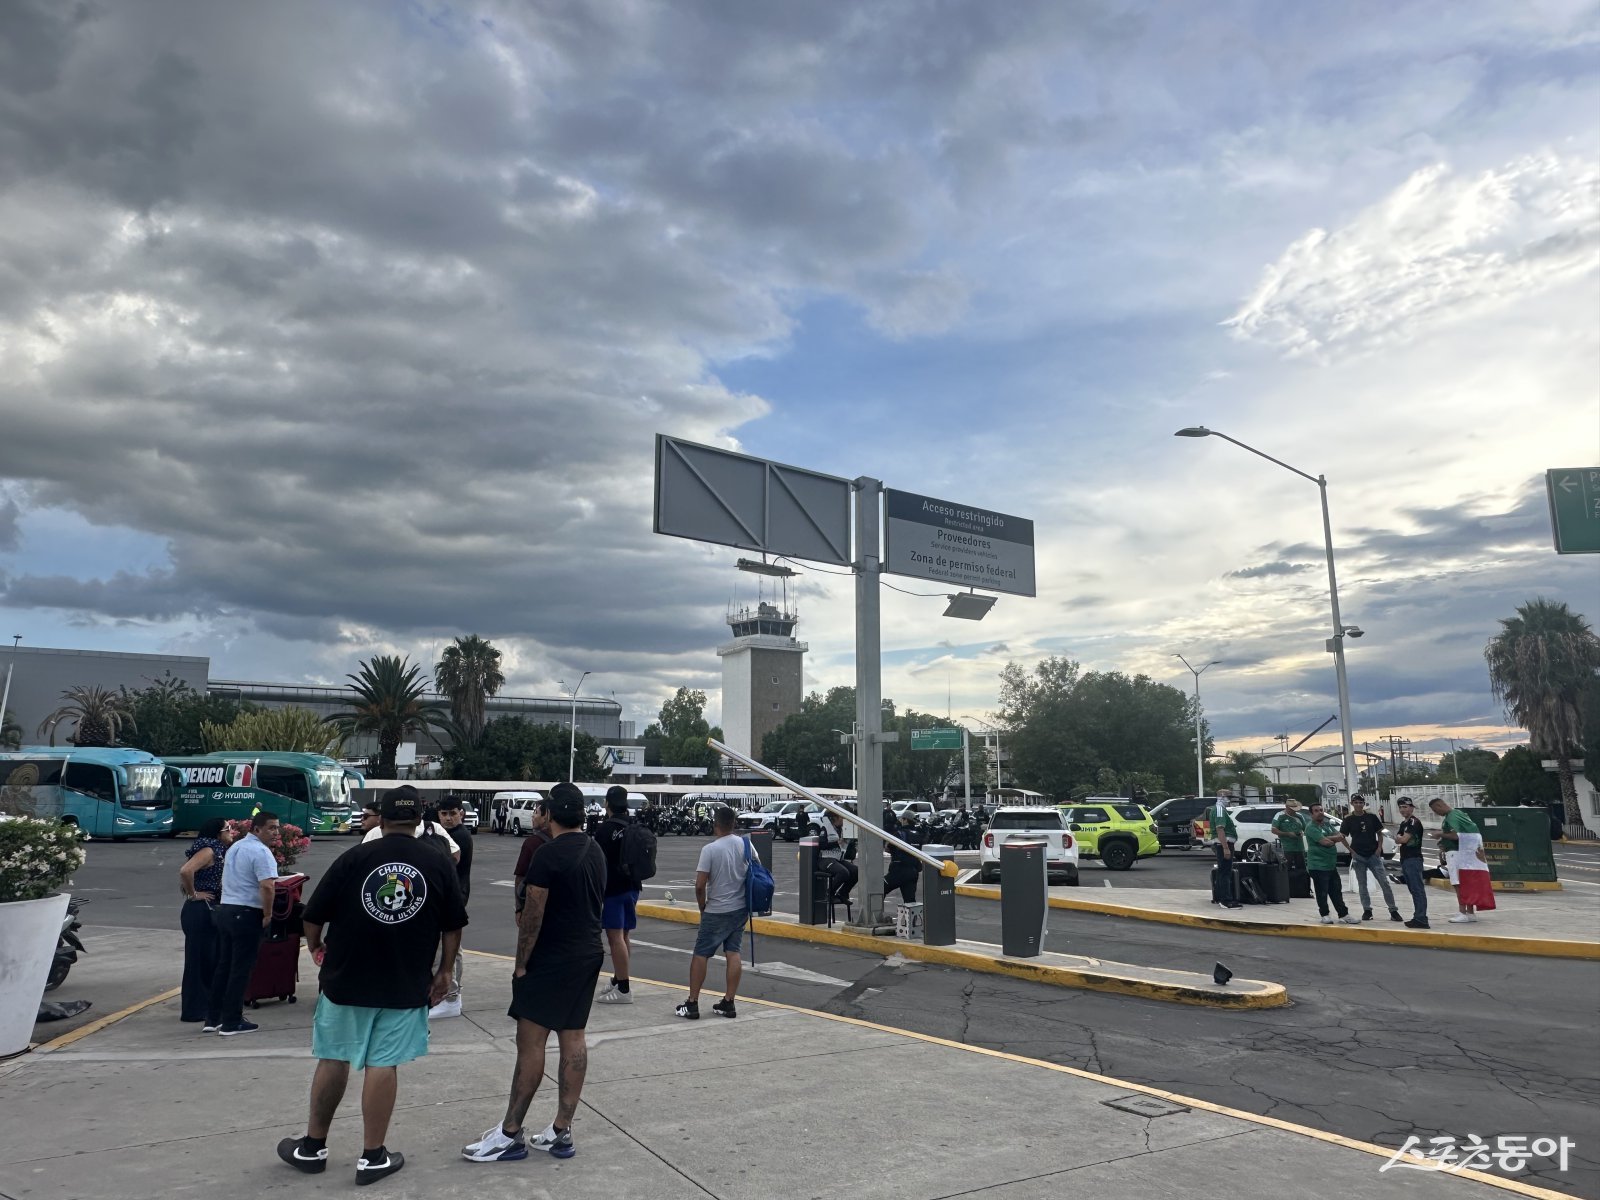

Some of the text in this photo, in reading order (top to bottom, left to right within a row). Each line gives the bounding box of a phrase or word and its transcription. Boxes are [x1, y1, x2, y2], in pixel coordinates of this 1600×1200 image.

[922, 500, 1004, 527] Acceso restringido
[944, 517, 984, 532] Restricted area
[937, 529, 991, 549] Proveedores
[930, 541, 998, 560] Service providers vehicles
[910, 550, 1016, 580] Zona de permiso federal
[928, 566, 949, 576] Federal
[981, 577, 1001, 587] parking
[378, 864, 418, 880] CHAVOS
[364, 892, 424, 922] FRONTERA ULTRAS
